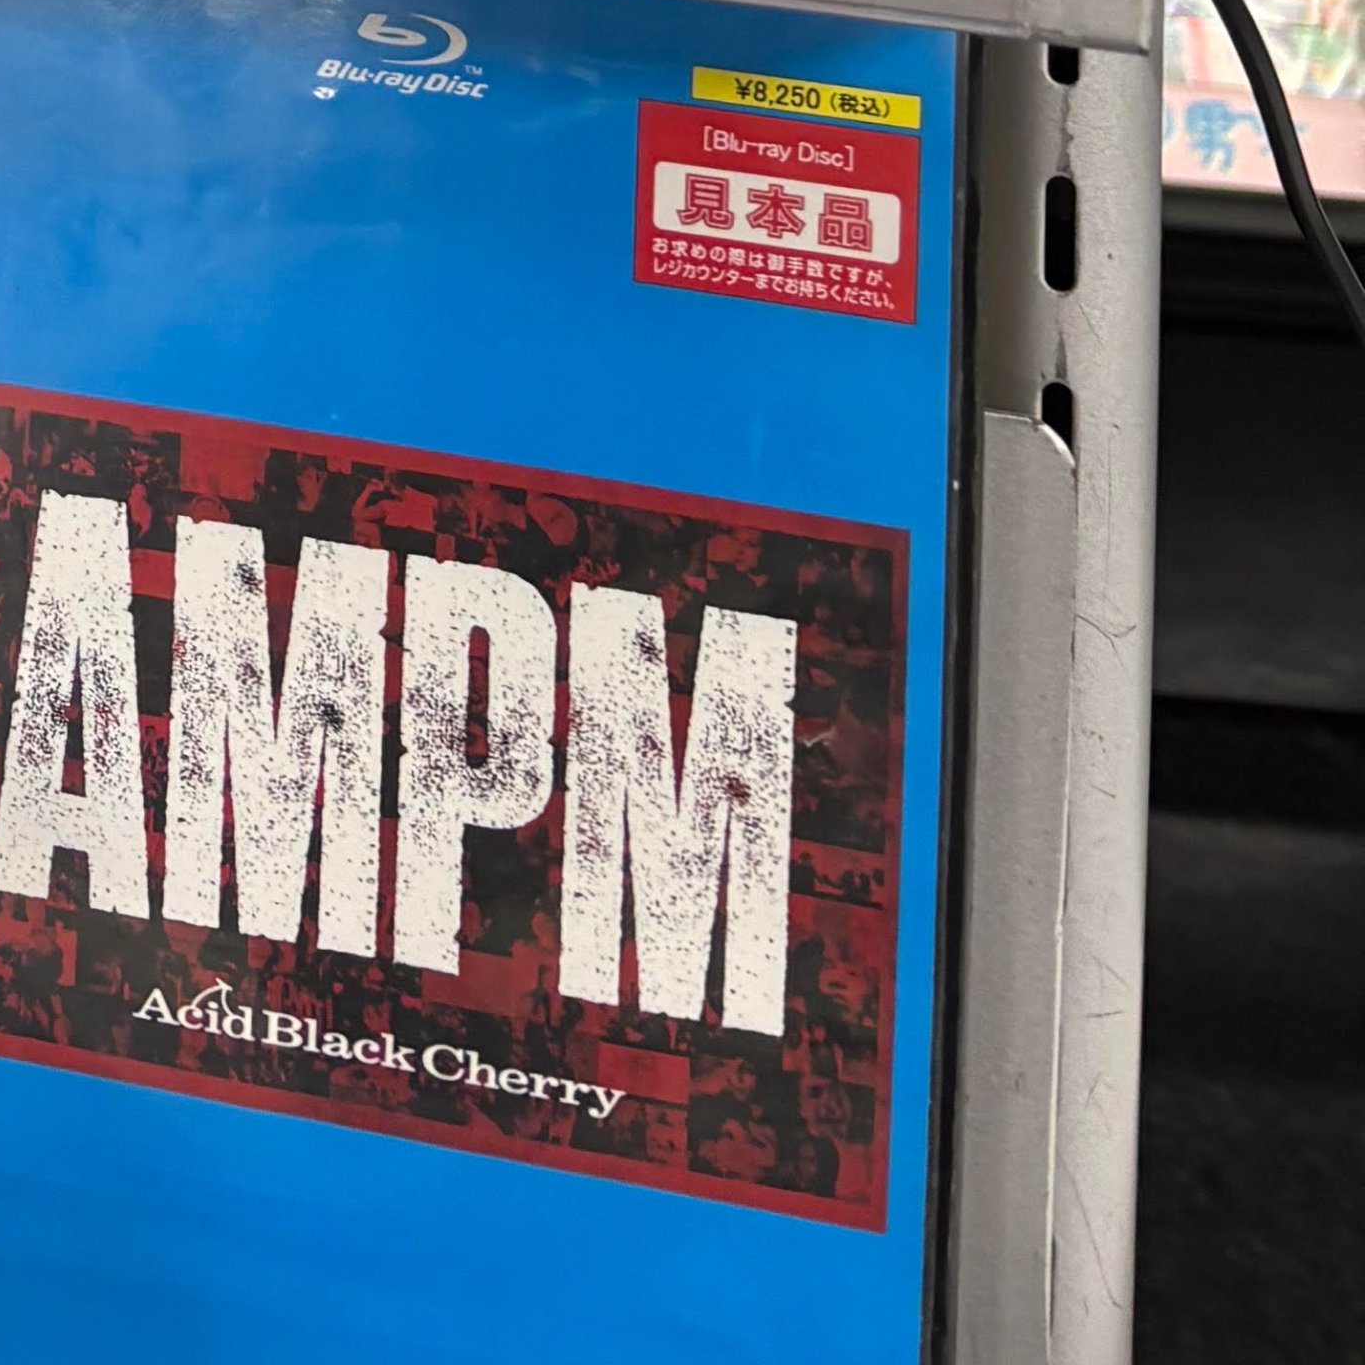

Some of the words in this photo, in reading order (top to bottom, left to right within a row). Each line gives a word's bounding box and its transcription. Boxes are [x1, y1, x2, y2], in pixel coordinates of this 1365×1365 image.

[316, 58, 424, 95] Blu-ray
[423, 72, 490, 99] Disc
[734, 77, 822, 110] ¥8,250
[676, 172, 874, 254] 見本品
[132, 977, 256, 1042] Acid
[262, 1010, 417, 1074] Black
[422, 1042, 626, 1121] Cherry
